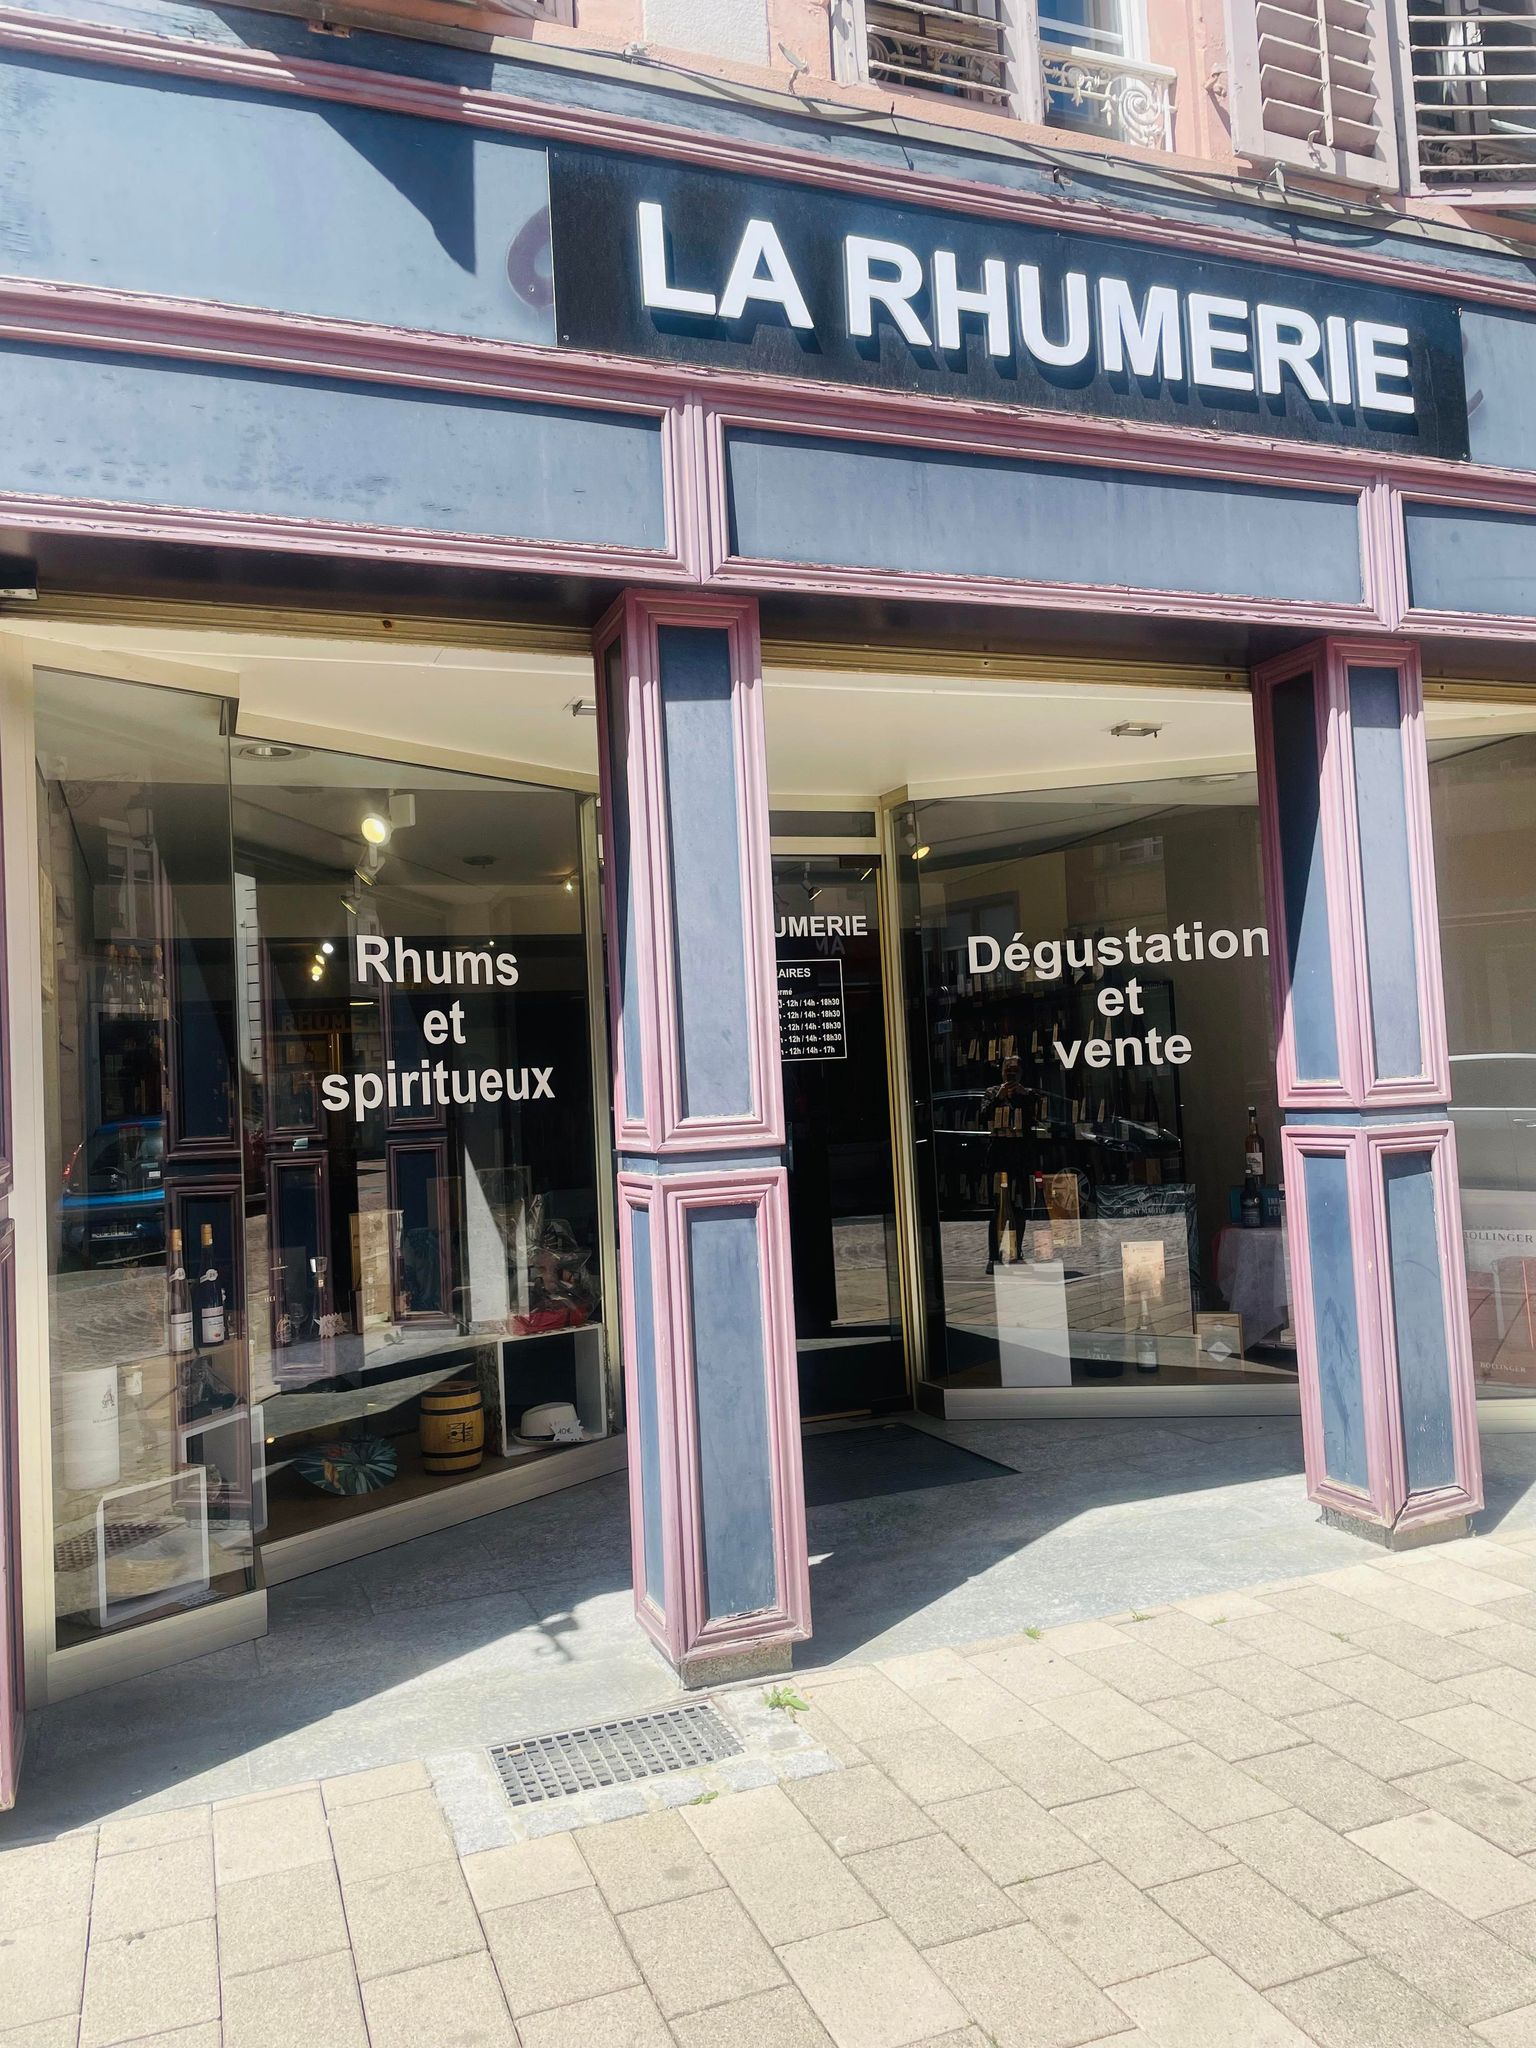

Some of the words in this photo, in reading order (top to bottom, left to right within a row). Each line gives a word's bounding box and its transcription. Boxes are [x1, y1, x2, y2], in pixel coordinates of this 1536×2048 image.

[637, 202, 815, 330] LA
[845, 235, 1415, 414] RHUMERIE
[356, 934, 519, 986] Rhums
[968, 922, 1269, 980] Dégustation
[777, 968, 811, 978] AIRES
[786, 999, 799, 1007] 12h
[803, 998, 816, 1007] 14h
[787, 1011, 799, 1019] 12h
[804, 1010, 816, 1019] 14h
[1097, 977, 1144, 1017] et
[423, 1000, 467, 1045] et
[787, 1023, 800, 1031] 12h
[804, 1022, 817, 1030] 14h
[788, 1035, 801, 1043] 12h
[805, 1034, 817, 1042] 14h
[789, 1047, 801, 1055] 12h
[806, 1046, 819, 1054] 14h
[1053, 1027, 1192, 1069] vente
[321, 1059, 555, 1122] spiritueux
